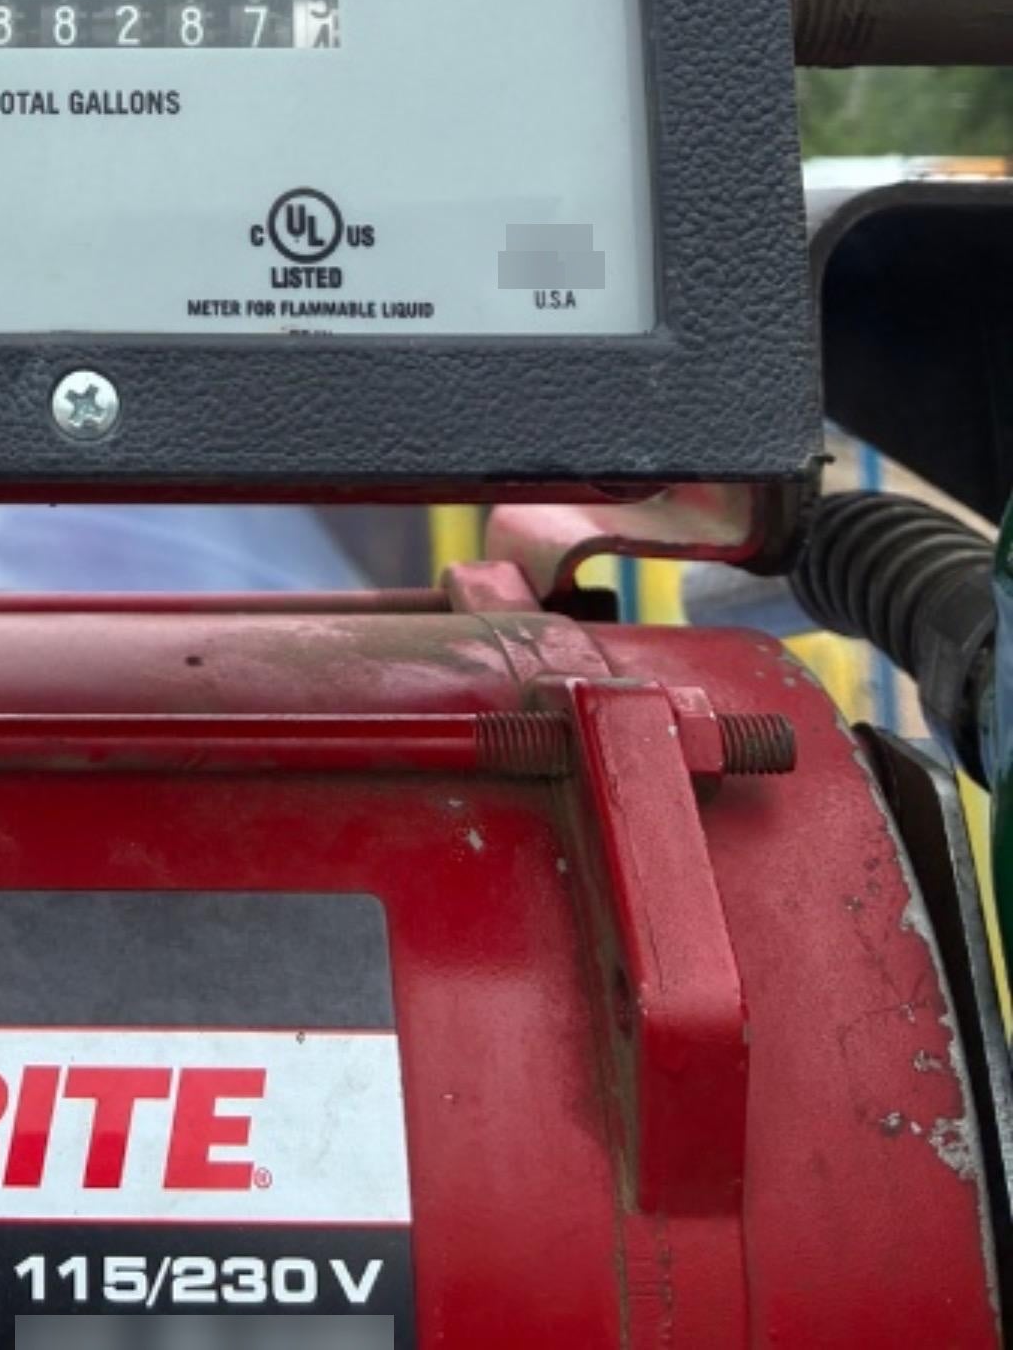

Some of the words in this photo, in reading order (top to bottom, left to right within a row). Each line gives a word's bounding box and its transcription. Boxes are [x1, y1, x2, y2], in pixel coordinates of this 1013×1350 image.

[68, 90, 181, 117] GALLONS
[346, 224, 376, 247] US
[270, 266, 343, 289] LISTED
[187, 300, 240, 317] METER
[246, 300, 276, 317] FOR
[280, 300, 377, 319] FLAMMABLE
[381, 301, 435, 319] LIQUID
